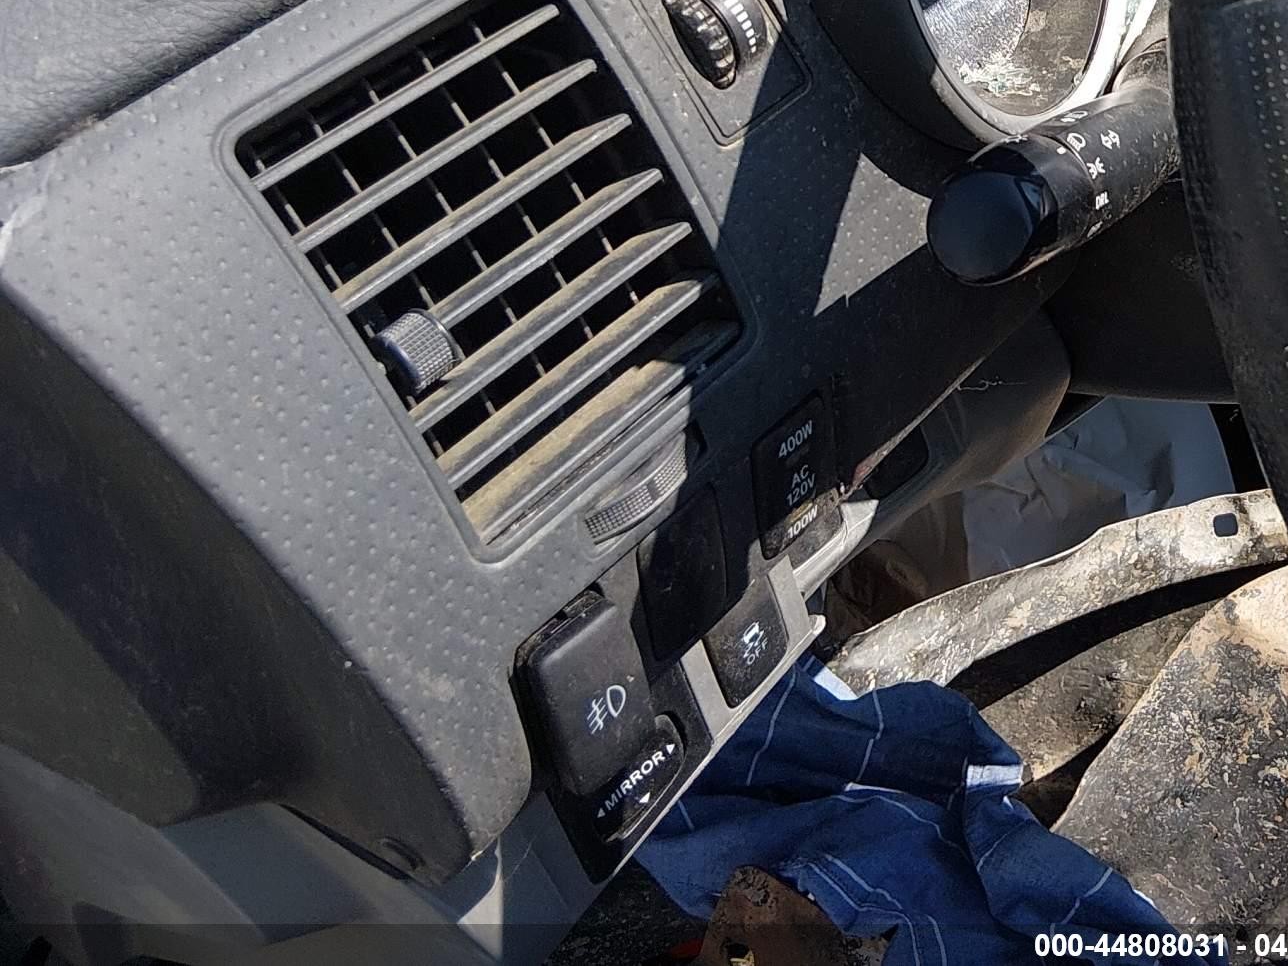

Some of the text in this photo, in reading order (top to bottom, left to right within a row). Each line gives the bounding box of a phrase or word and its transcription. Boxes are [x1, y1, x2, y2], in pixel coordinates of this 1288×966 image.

[779, 420, 813, 458] 400W
[786, 473, 816, 506] 120V
[791, 464, 809, 489] AC
[787, 504, 818, 539] 100W
[747, 638, 769, 665] OFF
[604, 750, 666, 812] MIRROR
